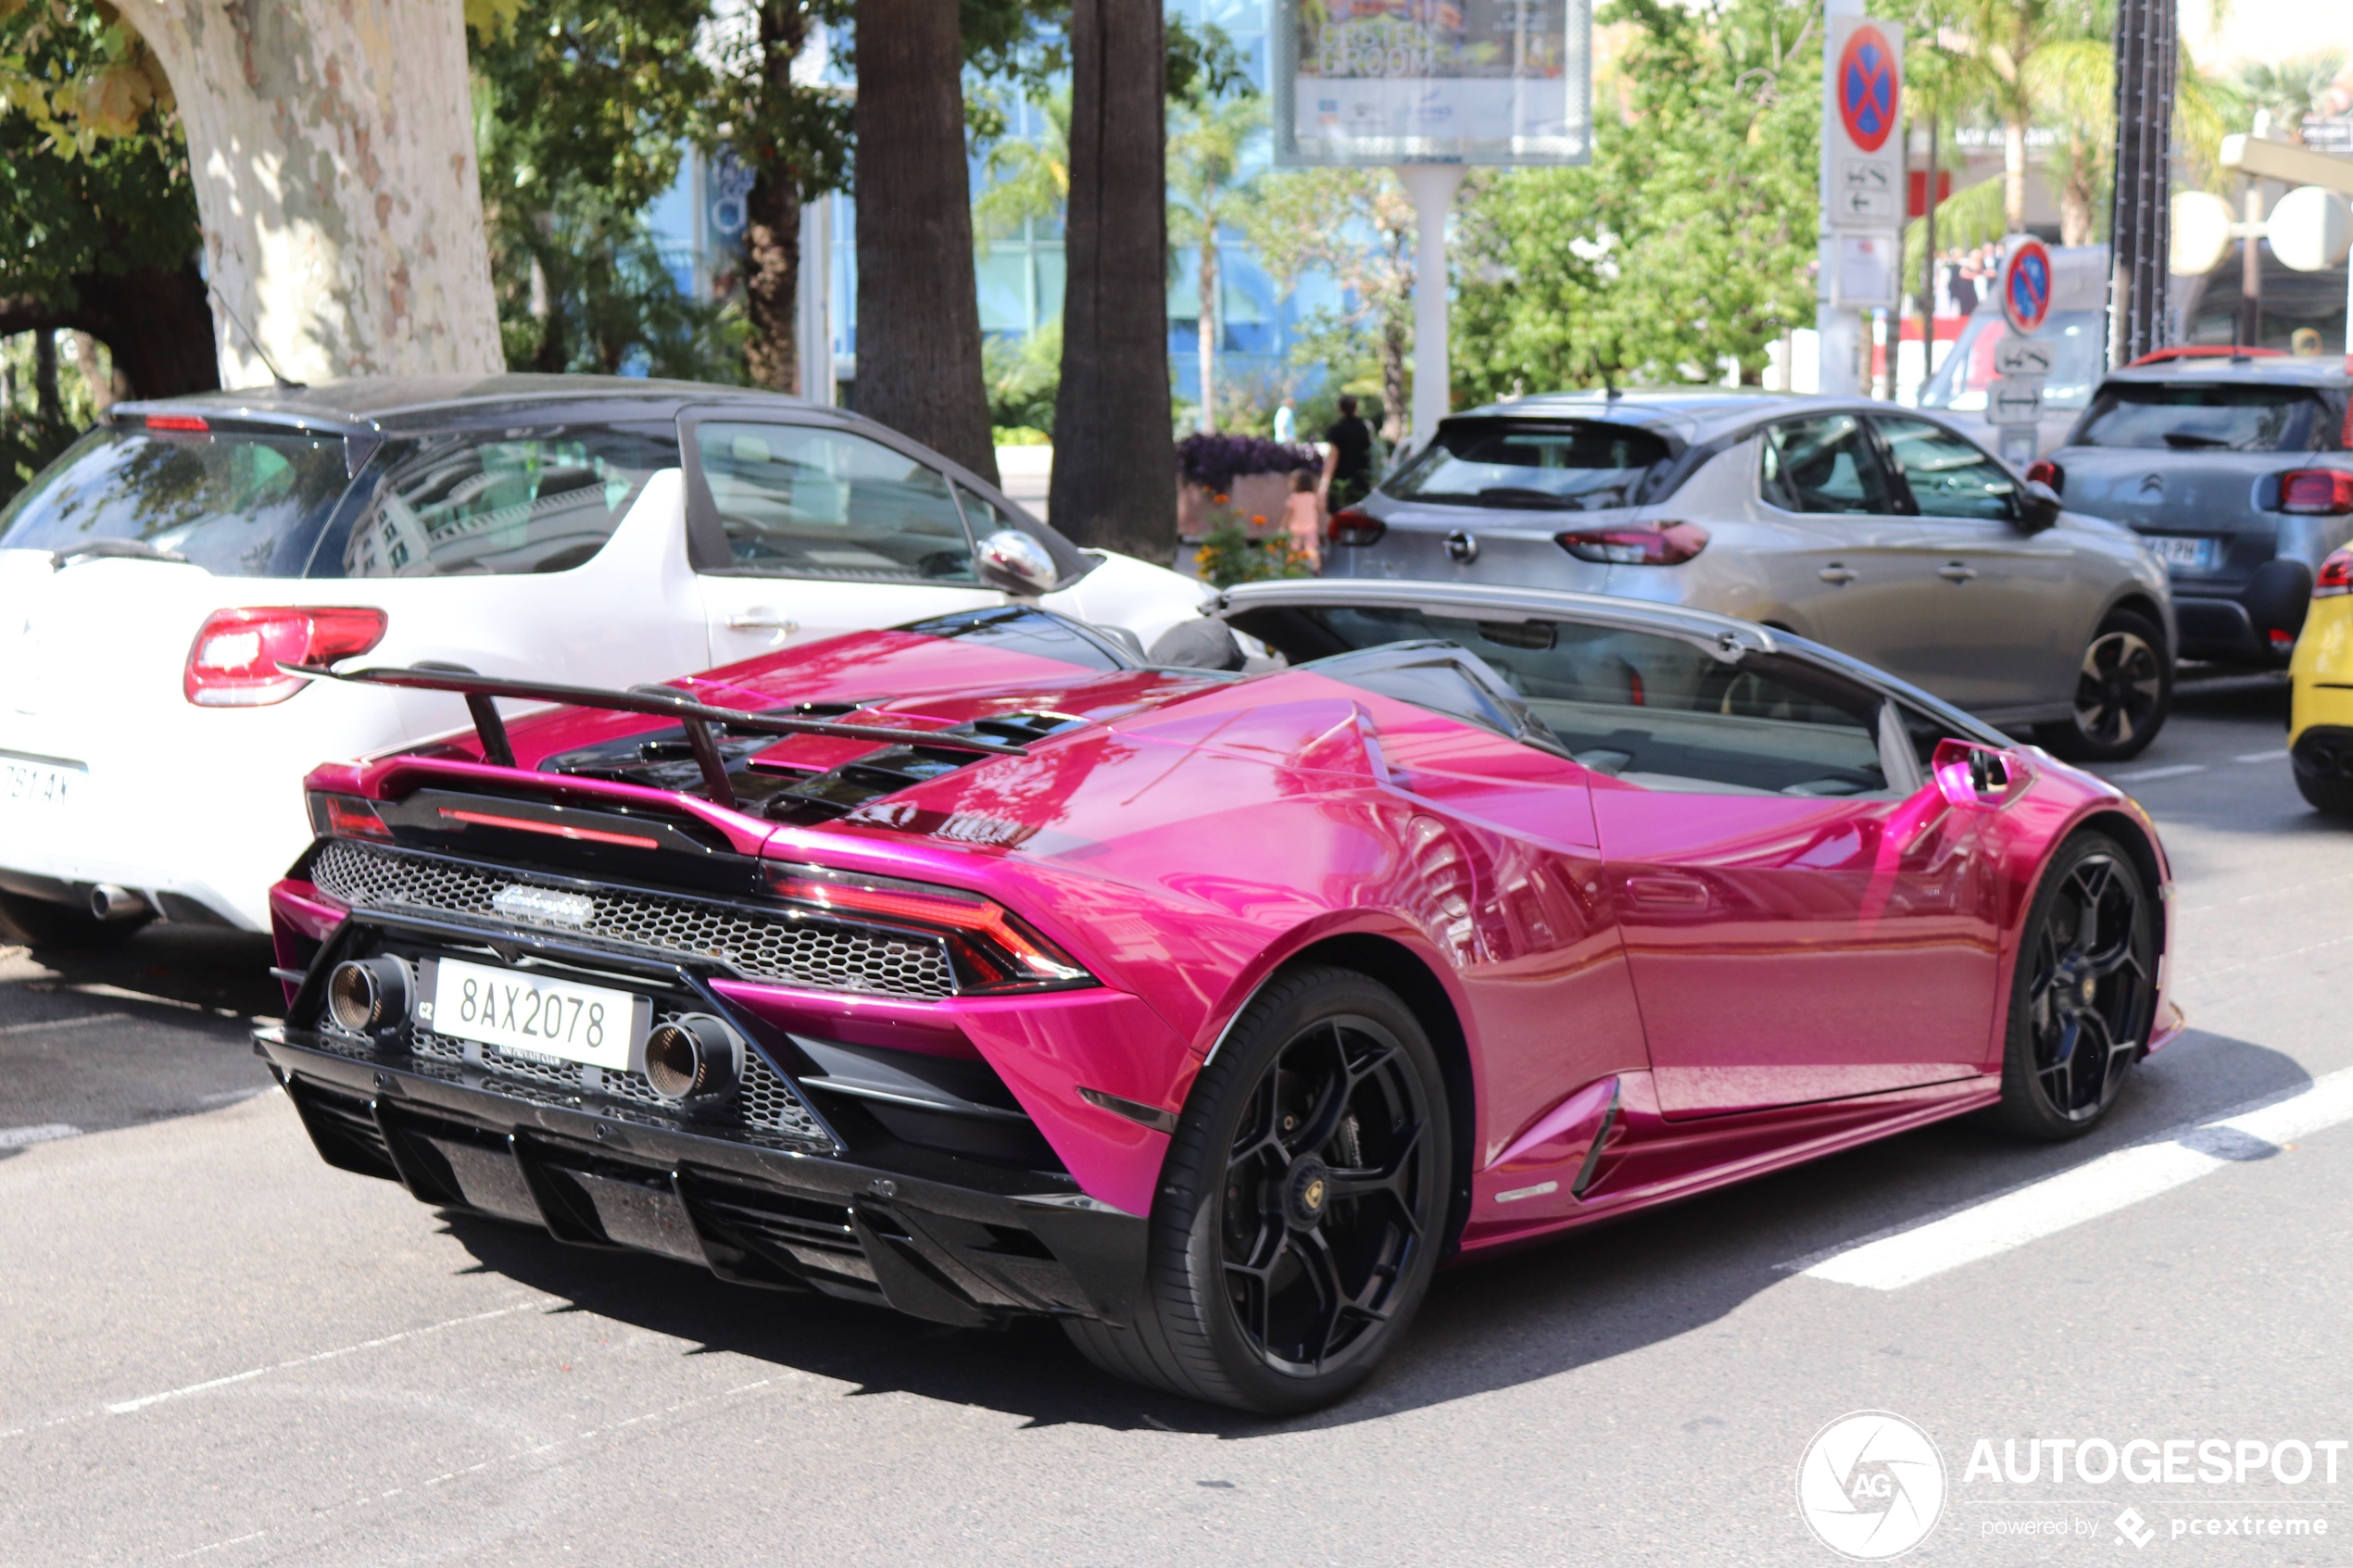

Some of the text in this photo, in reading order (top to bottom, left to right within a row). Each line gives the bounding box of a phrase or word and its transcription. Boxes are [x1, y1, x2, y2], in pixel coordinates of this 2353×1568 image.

[418, 978, 604, 1048] CZ 8AX2078
[541, 1054, 561, 1066] CLUB
